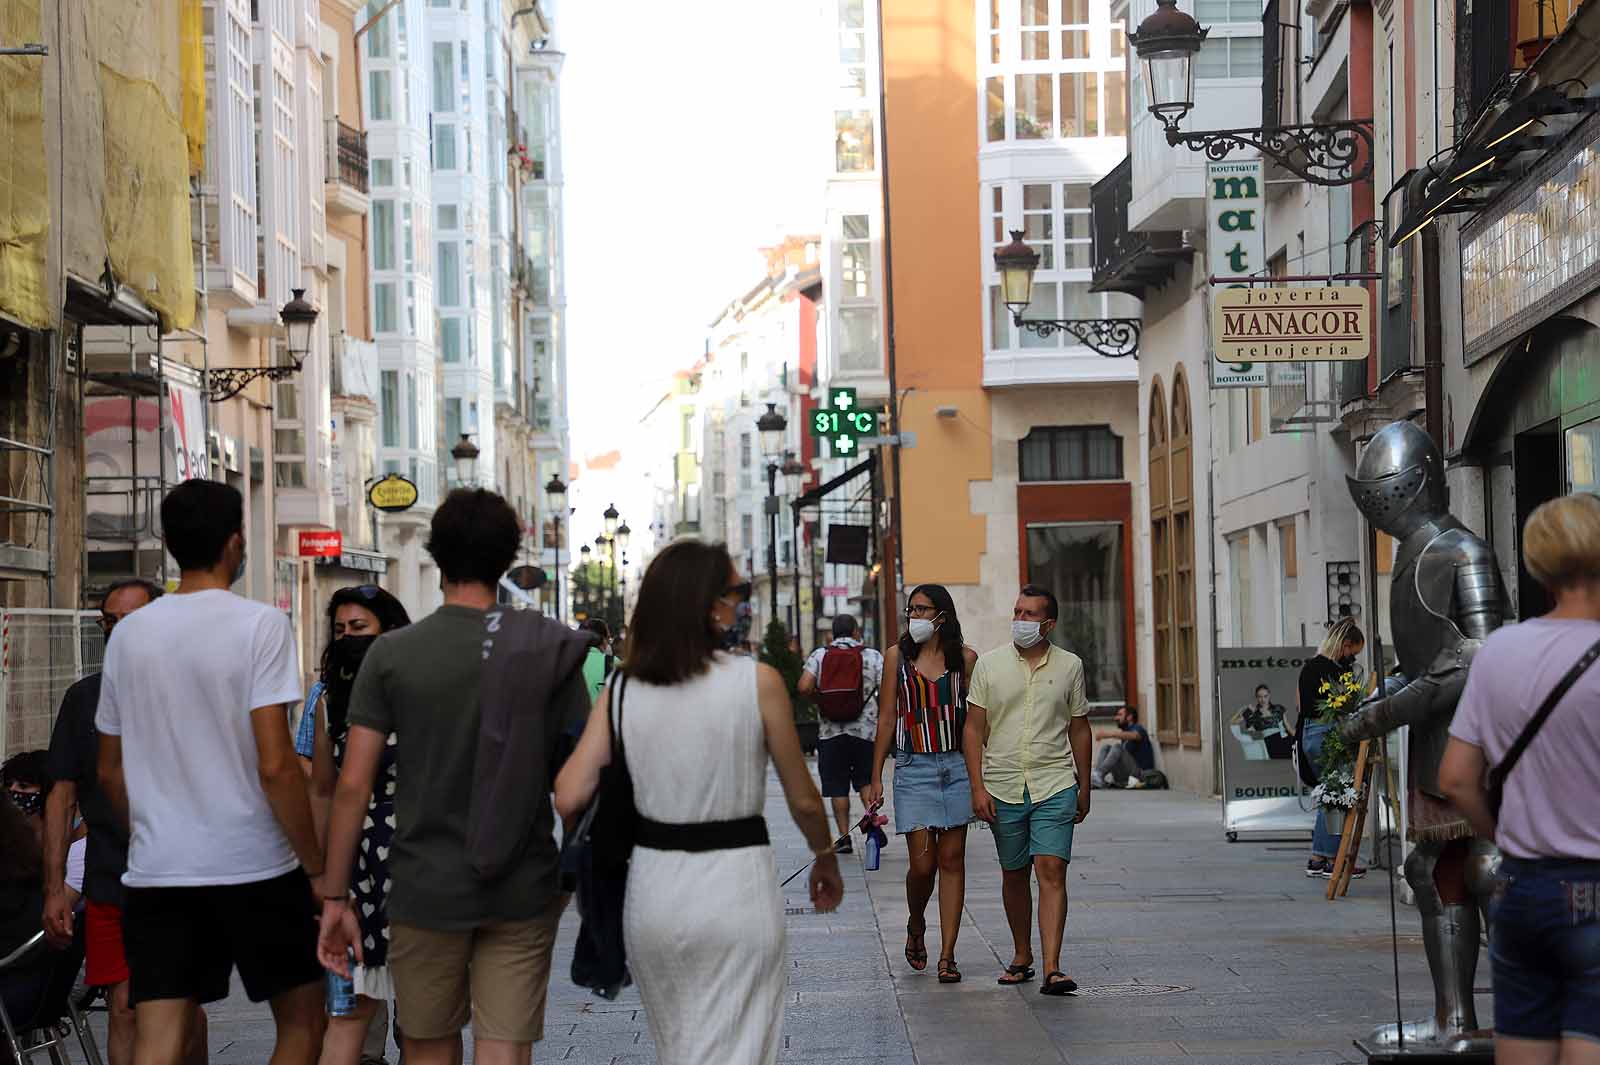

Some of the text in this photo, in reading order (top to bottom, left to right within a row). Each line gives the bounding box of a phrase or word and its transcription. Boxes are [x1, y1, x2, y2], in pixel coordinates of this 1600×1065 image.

[1211, 164, 1259, 173] BOUTIQUE
[1245, 288, 1340, 304] joyería
[1223, 311, 1361, 336] MANACOR
[1236, 343, 1348, 359] relojería
[1216, 375, 1264, 383] BOUTIQUE
[815, 412, 873, 433] 31 °C
